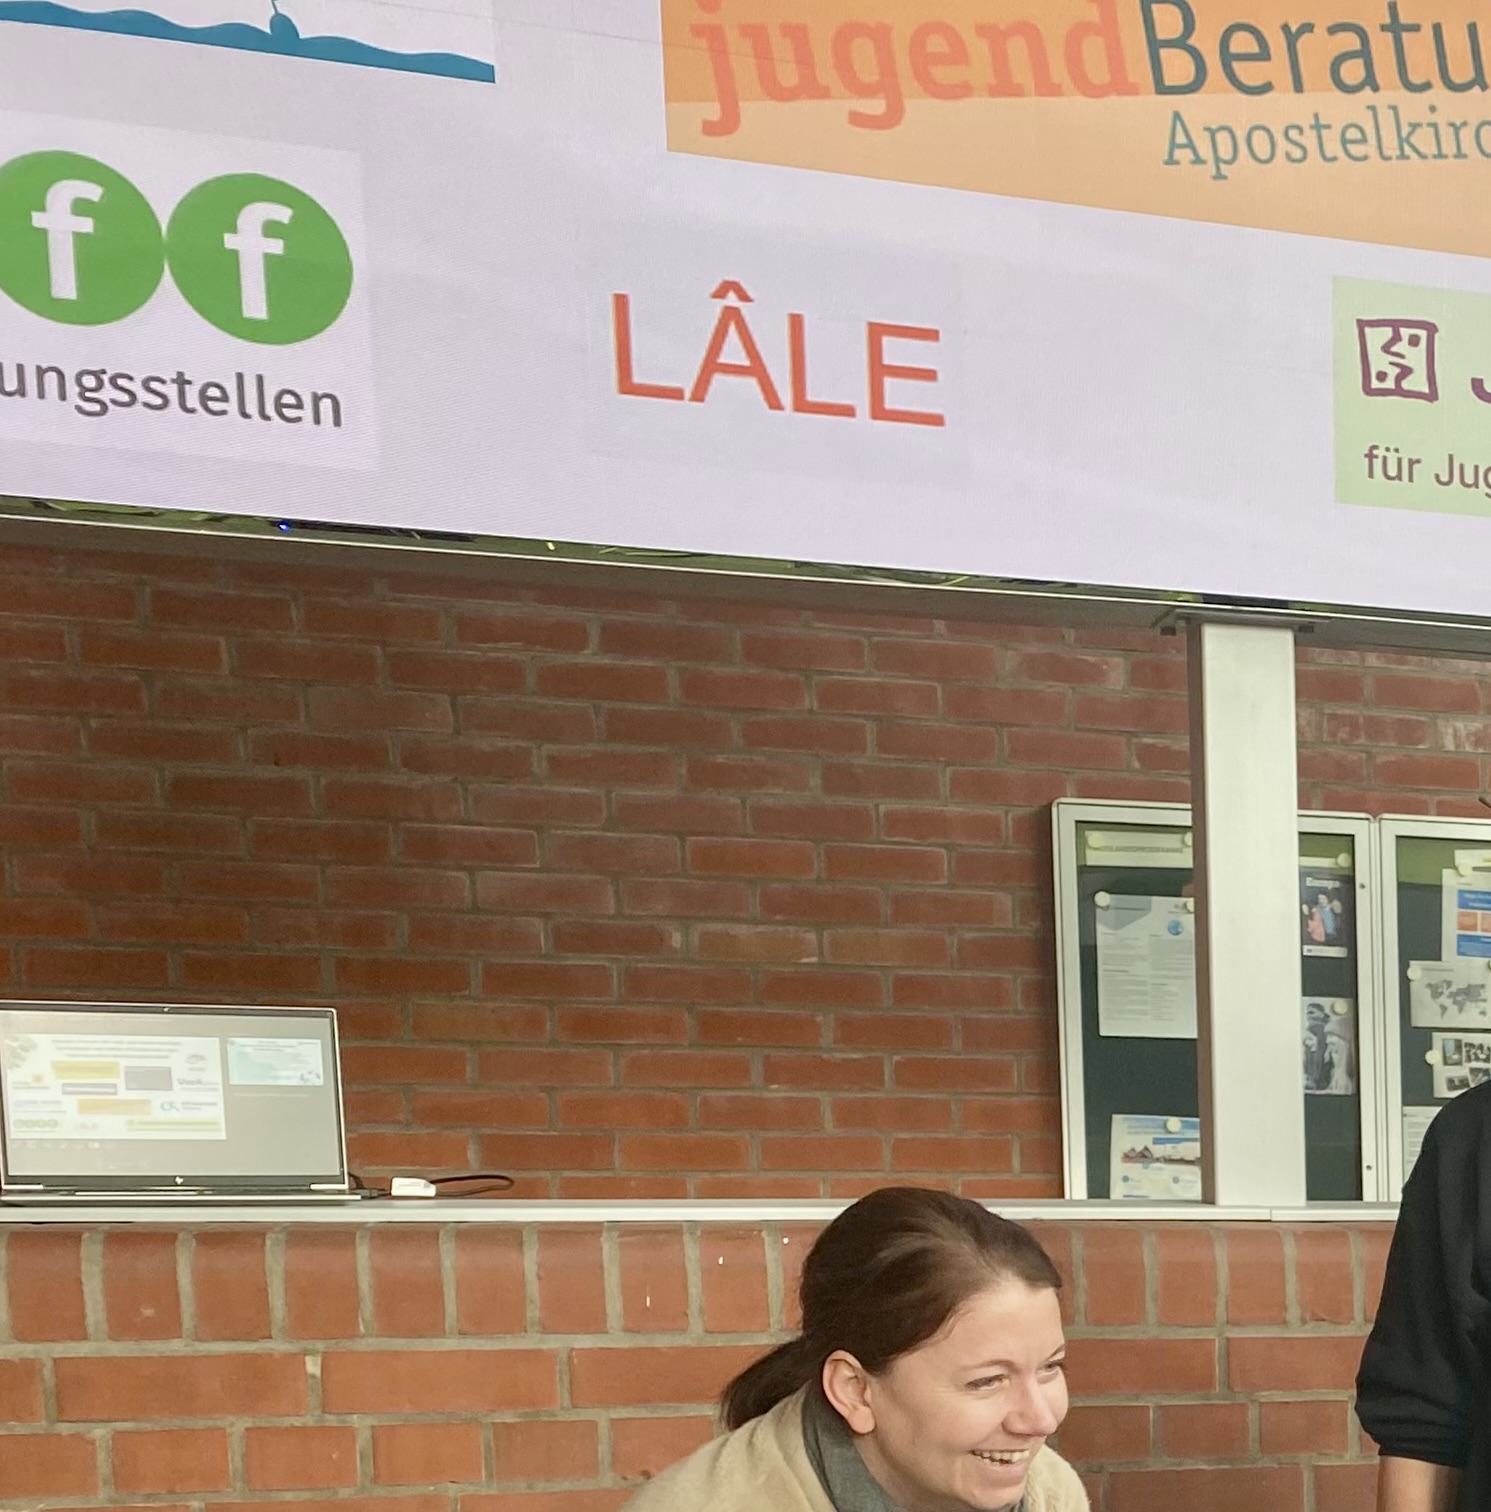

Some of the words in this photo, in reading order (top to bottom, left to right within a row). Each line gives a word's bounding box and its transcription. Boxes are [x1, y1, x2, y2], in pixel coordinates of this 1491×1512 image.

[612, 279, 945, 427] LÂLE
[0, 361, 343, 427] ungsstellen
[1363, 444, 1420, 485] für
